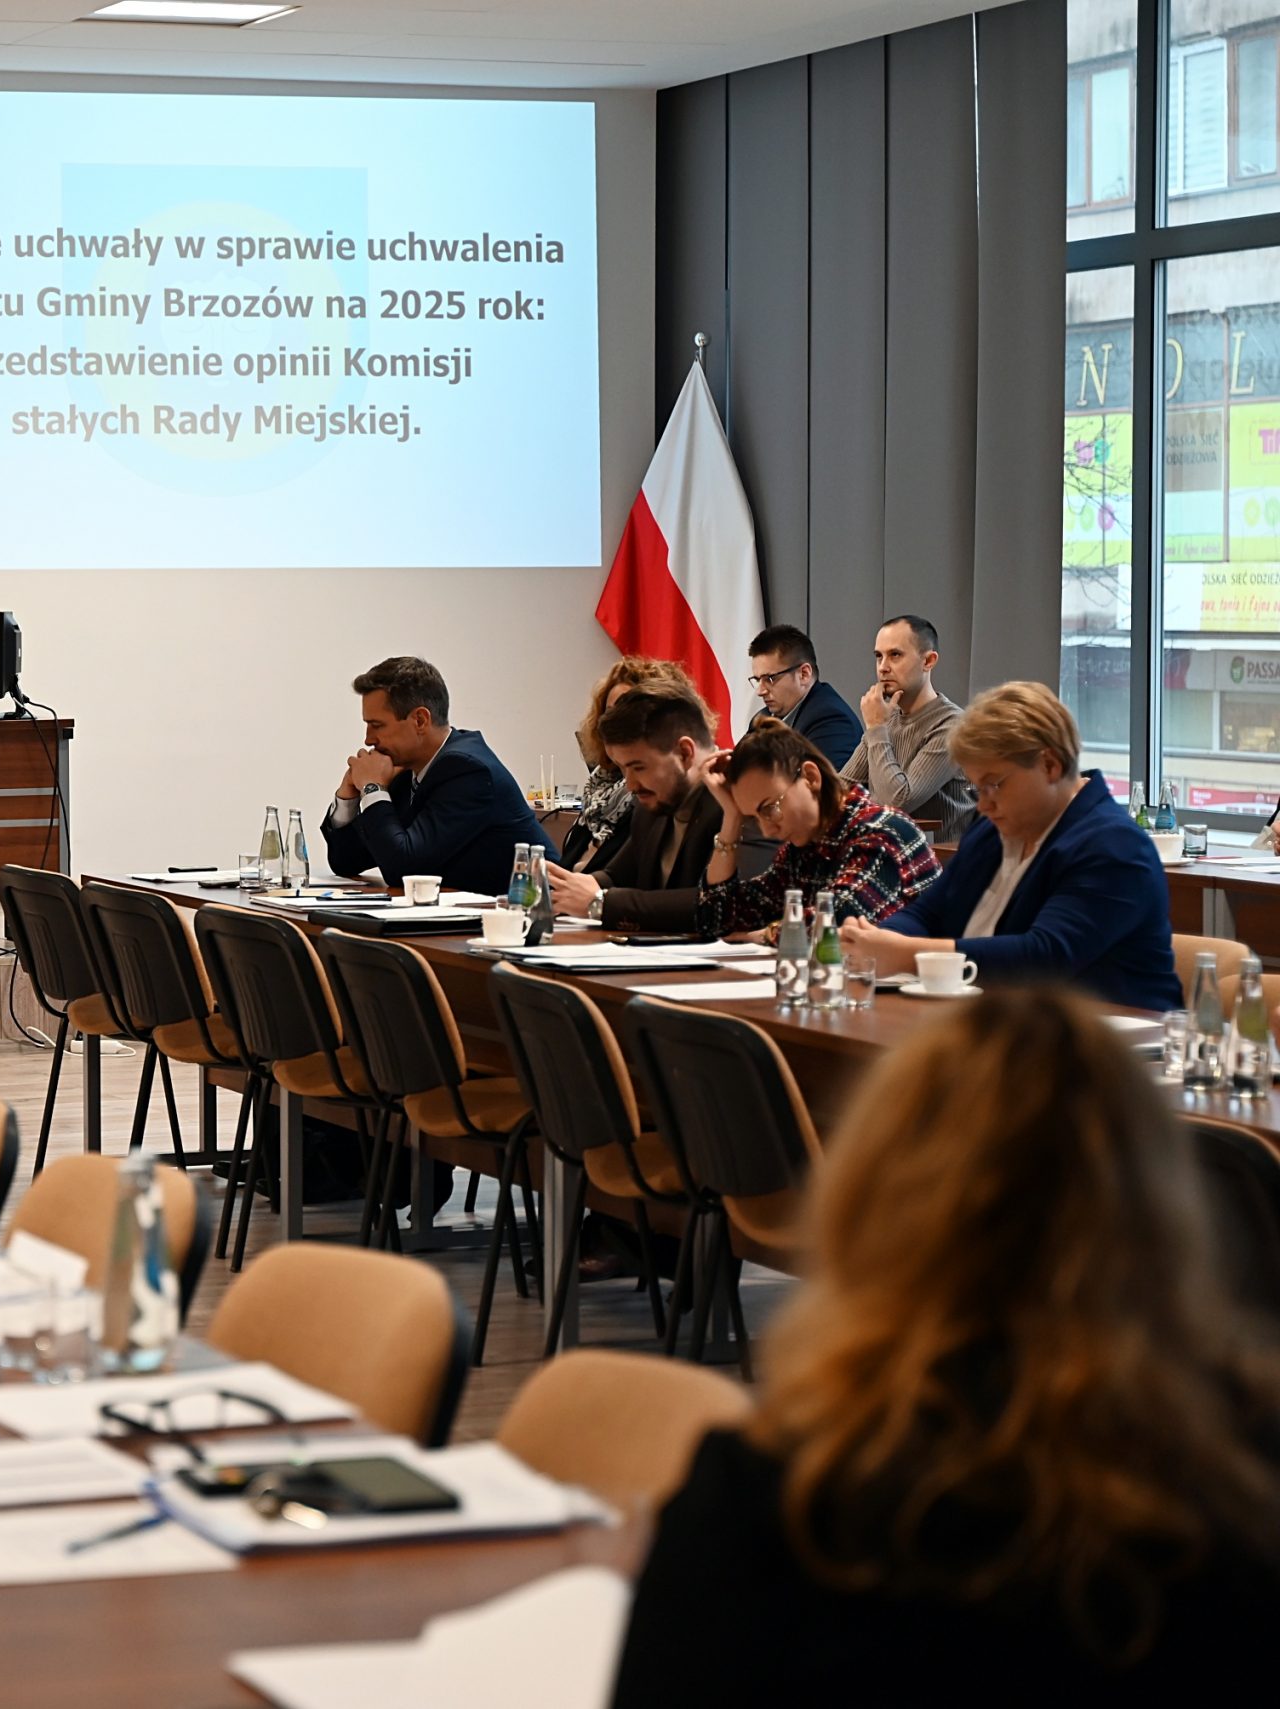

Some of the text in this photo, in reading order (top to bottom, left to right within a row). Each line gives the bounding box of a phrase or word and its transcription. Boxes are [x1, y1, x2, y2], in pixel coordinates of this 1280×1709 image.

[14, 226, 164, 267] uchwały
[174, 235, 206, 259] w
[216, 229, 356, 268] sprawie
[367, 230, 565, 264] uchwalenia
[36, 285, 152, 325] Gminy
[163, 285, 314, 319] Brzozów
[325, 295, 367, 320] na
[379, 289, 466, 321] 2025
[478, 289, 545, 321] rok:
[233, 345, 331, 384] opinii
[343, 346, 472, 386] Komisji
[12, 403, 421, 443] stałych Rady Miejskiej.
